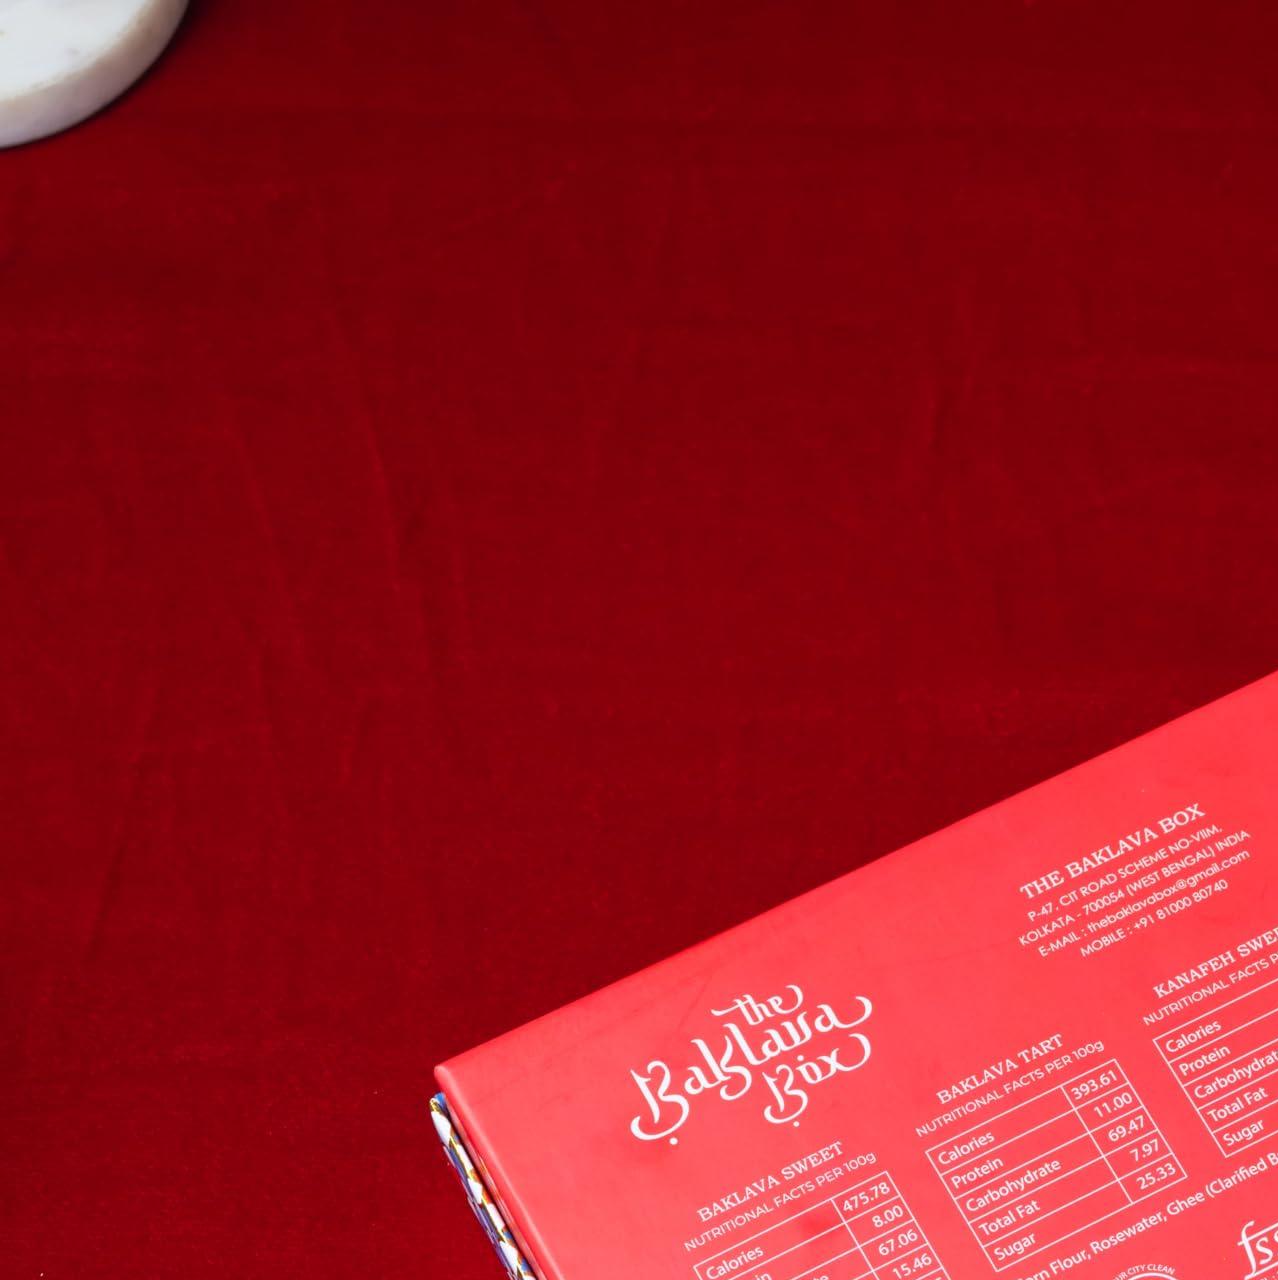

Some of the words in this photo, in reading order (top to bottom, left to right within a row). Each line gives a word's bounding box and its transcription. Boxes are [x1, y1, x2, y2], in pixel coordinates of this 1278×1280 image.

[1018, 914, 1076, 946] KOLKATA
[1082, 889, 1125, 916] 700054
[1126, 871, 1161, 896] (WEST
[1161, 845, 1216, 878] BENGAL)
[1214, 830, 1251, 852] INDIA
[1019, 870, 1065, 899] THE
[1064, 827, 1159, 879] BAKLAVA
[1157, 802, 1206, 834] BOX
[1058, 890, 1079, 906] CIT
[1079, 873, 1118, 897] ROAD
[1117, 847, 1169, 879] SCHEME
[1037, 931, 1081, 958] E-MAIL
[1086, 850, 1251, 933] thebaklavabox@gmail.com
[1080, 928, 1126, 957] MOBILE
[1133, 914, 1155, 929] +91
[1155, 896, 1193, 920] 81000
[1192, 879, 1229, 903] 80740
[710, 984, 804, 1026] the
[1142, 980, 1230, 1026] NUTRITIONAL
[1228, 958, 1270, 984] FACTS
[1152, 950, 1236, 999] KANAFEH
[630, 996, 873, 1145] Baklava
[936, 1058, 1019, 1105] BAKLAVA
[1017, 1033, 1063, 1063] TART
[1165, 1020, 1222, 1053] Calories
[1178, 1046, 1231, 1076] Protein
[761, 1033, 872, 1127] Box
[915, 1090, 1004, 1137] NUTRITIONAL
[1003, 1068, 1045, 1095] FACTS
[1044, 1054, 1073, 1074] PER
[1071, 1040, 1105, 1060] 100g
[937, 1132, 995, 1165] Calories
[1071, 1070, 1117, 1100] 393.61
[1206, 1097, 1245, 1122] Total
[1243, 1087, 1269, 1105] Fat
[950, 1158, 1004, 1189] Protein
[1093, 1092, 1133, 1118] 11.00
[965, 1160, 1062, 1212] Carbohydrate
[1108, 1114, 1144, 1142] 69.47
[1222, 1119, 1265, 1147] Sugar
[684, 1203, 774, 1252] NUTRITIONAL
[773, 1180, 816, 1208] FACTS
[815, 1167, 845, 1187] PER
[842, 1152, 877, 1172] 100g
[696, 1175, 781, 1222] BAKLAVA
[780, 1140, 843, 1181] SWEET
[871, 1205, 904, 1228] 8.00
[978, 1210, 1017, 1236] Total
[1015, 1200, 1041, 1219] Fat
[1129, 1138, 1159, 1162] 7.97
[993, 1233, 1036, 1261] Sugar
[1136, 1162, 1176, 1190] 25.33
[1049, 1249, 1092, 1275] Flour,
[1089, 1211, 1168, 1255] Rosewater,
[1166, 1192, 1206, 1216] Ghee
[1205, 1157, 1268, 1198] (Clarified
[705, 1246, 764, 1280] Calories
[843, 1181, 891, 1211] 475.78
[878, 1228, 918, 1256] 67.06
[892, 1252, 933, 1280] 15.46
[1127, 1264, 1145, 1275] CITY
[1146, 1263, 1175, 1275] CLEAN
